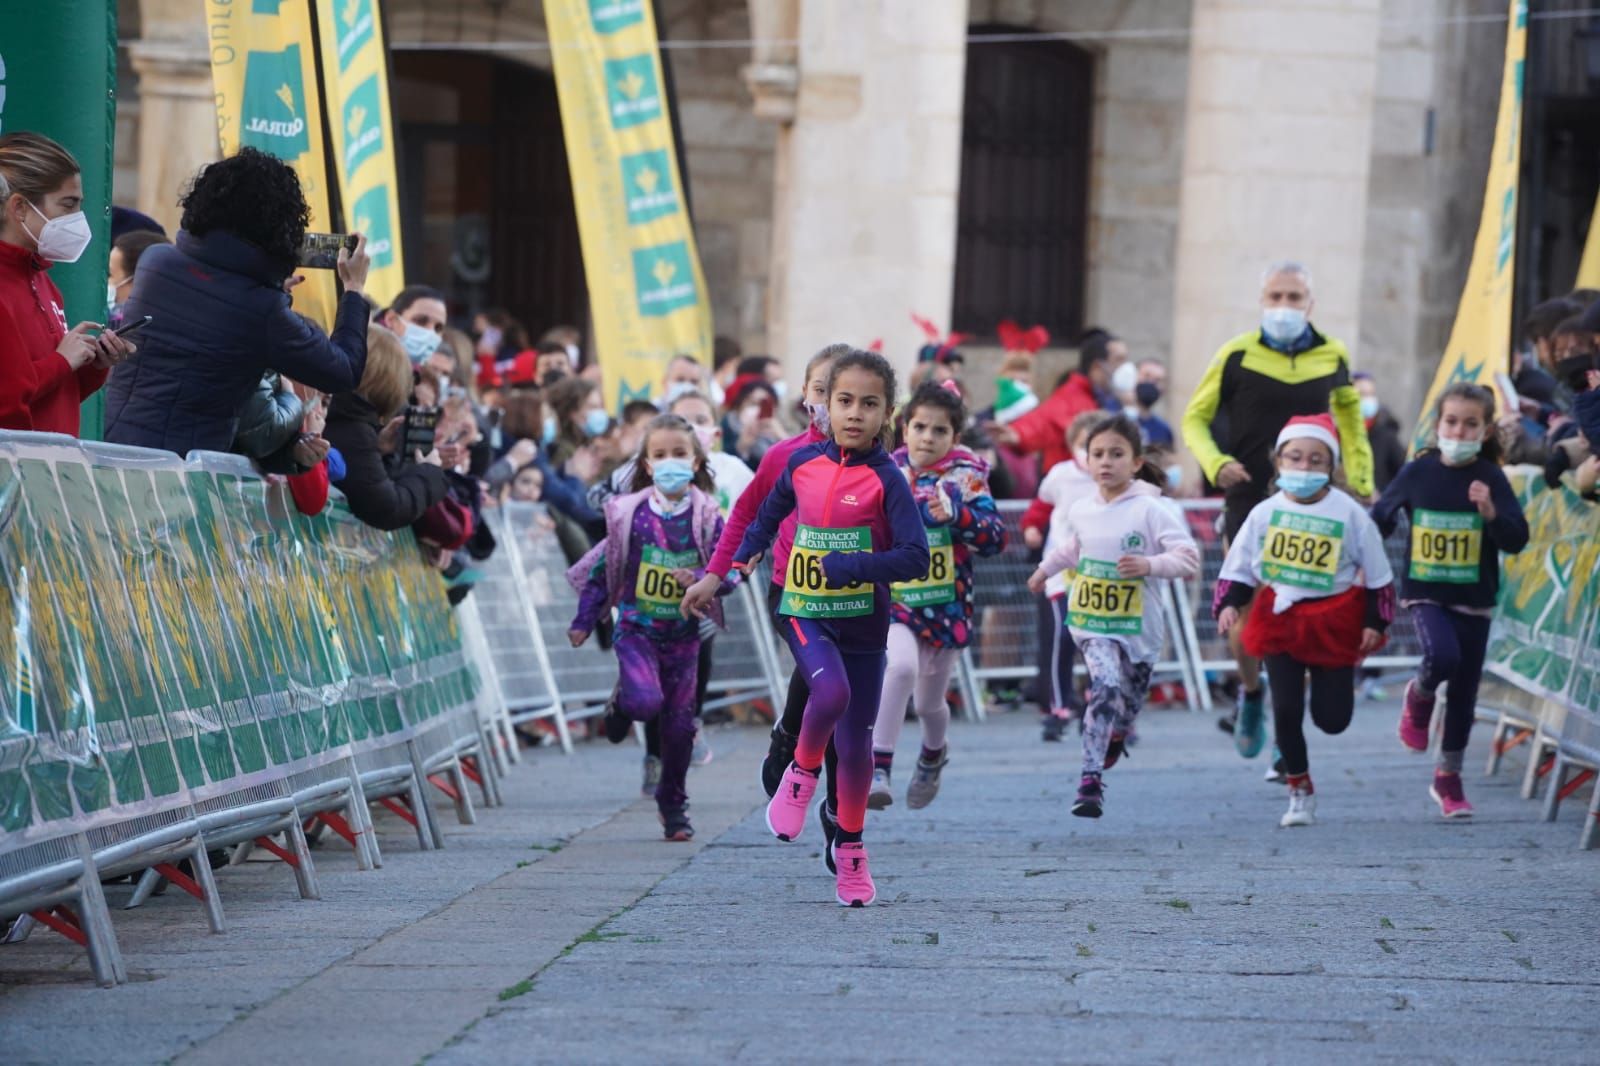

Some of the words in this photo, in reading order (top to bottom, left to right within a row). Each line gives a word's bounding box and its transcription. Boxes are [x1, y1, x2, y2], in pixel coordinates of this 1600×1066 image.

[807, 531, 860, 541] FUNDACION
[807, 540, 827, 549] CAJA
[829, 540, 860, 549] RURAL
[1271, 532, 1332, 568] 0582
[1421, 532, 1470, 561] 0911
[792, 552, 862, 591] 06
[806, 603, 830, 612] CAJA
[833, 600, 869, 611] RURAL
[1078, 580, 1137, 613] 0567
